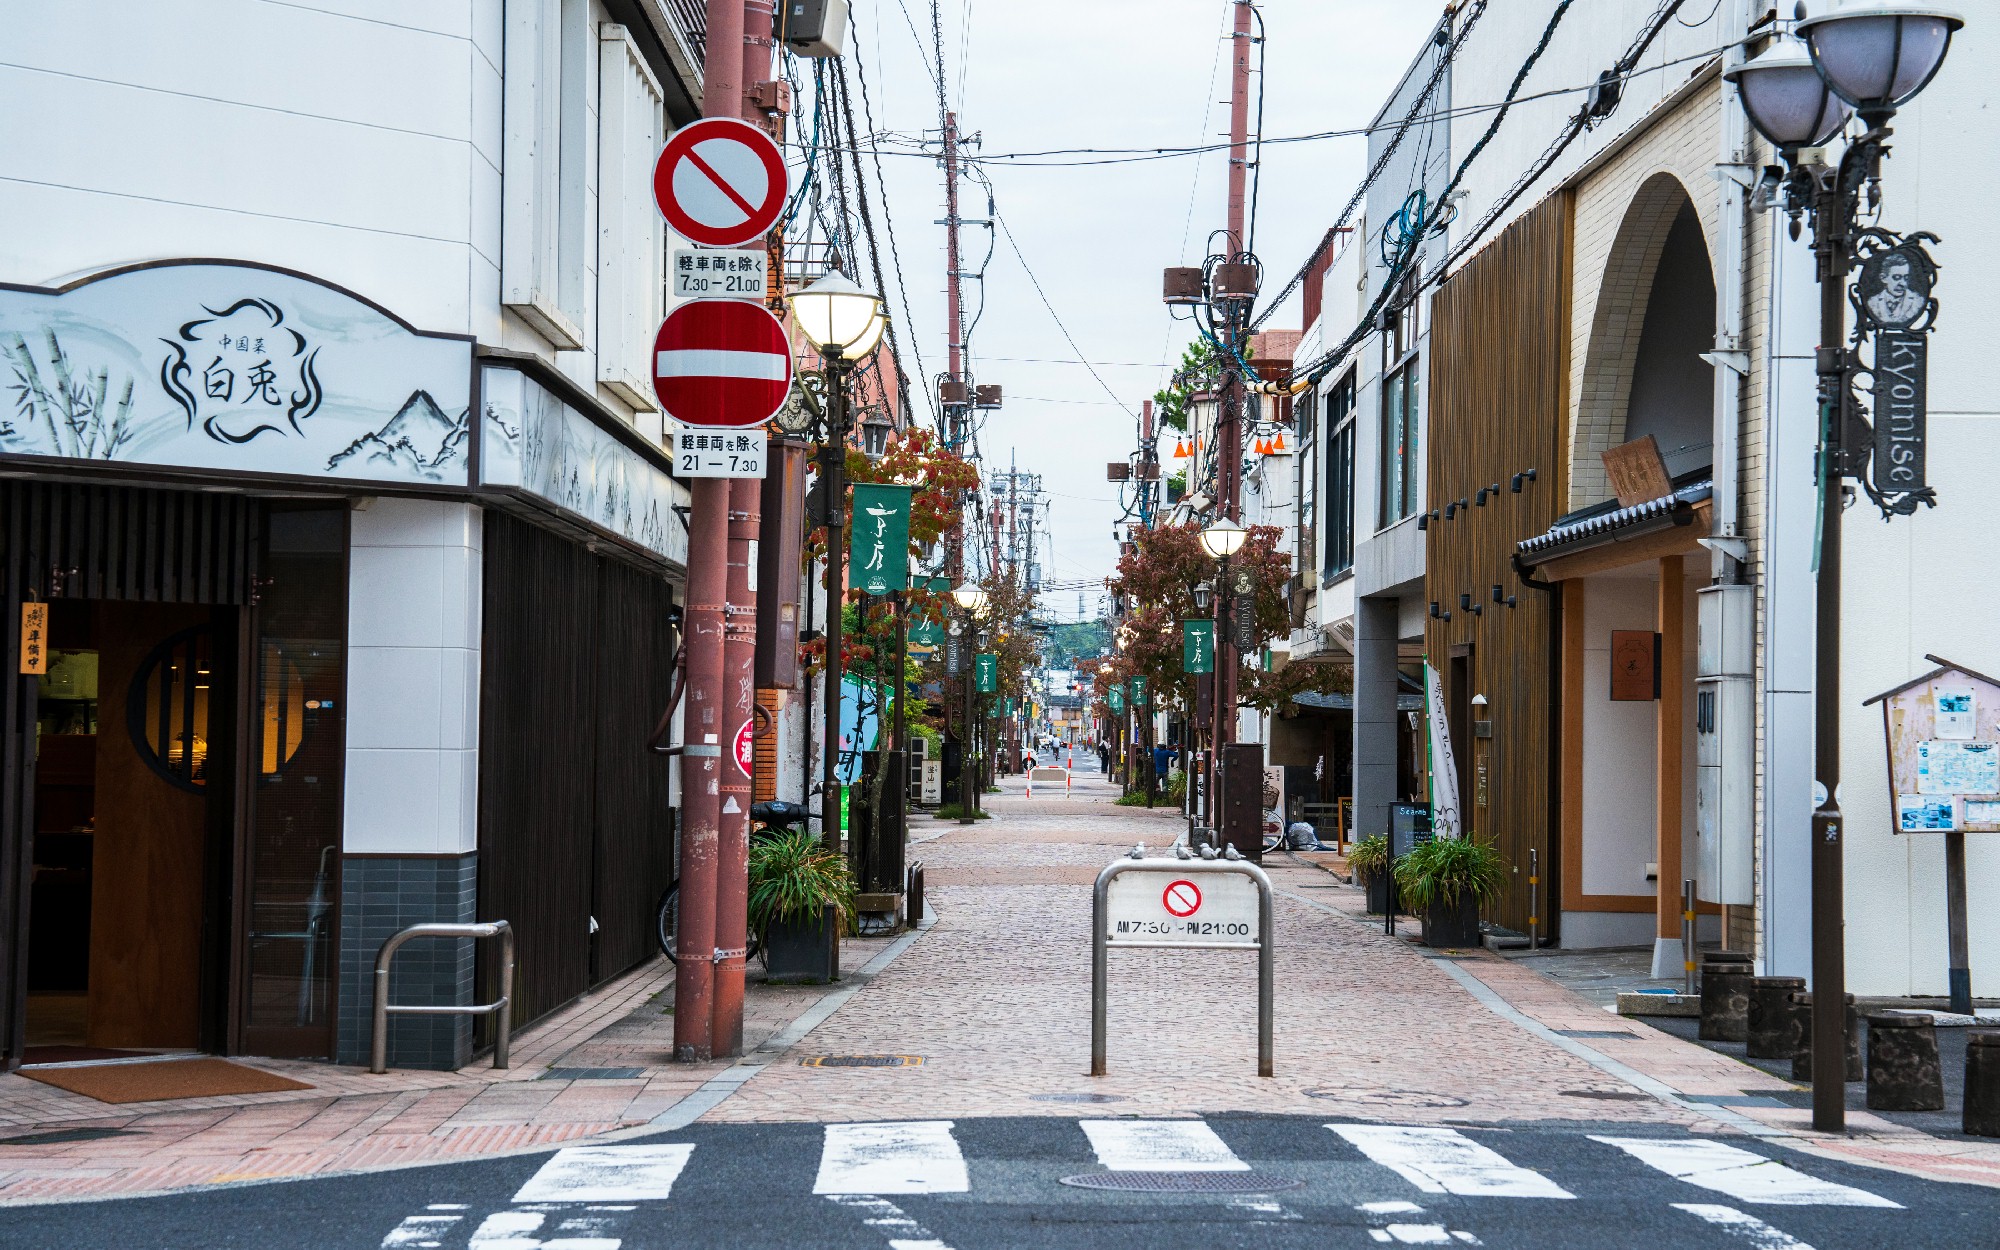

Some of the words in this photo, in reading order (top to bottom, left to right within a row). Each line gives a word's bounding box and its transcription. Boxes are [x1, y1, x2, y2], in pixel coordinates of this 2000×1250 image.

[679, 255, 762, 272] 軽車両を除く
[218, 333, 266, 354] 中国菜
[681, 434, 759, 452] 軽車両を除く
[682, 454, 699, 471] 21
[728, 455, 758, 472] 7.30
